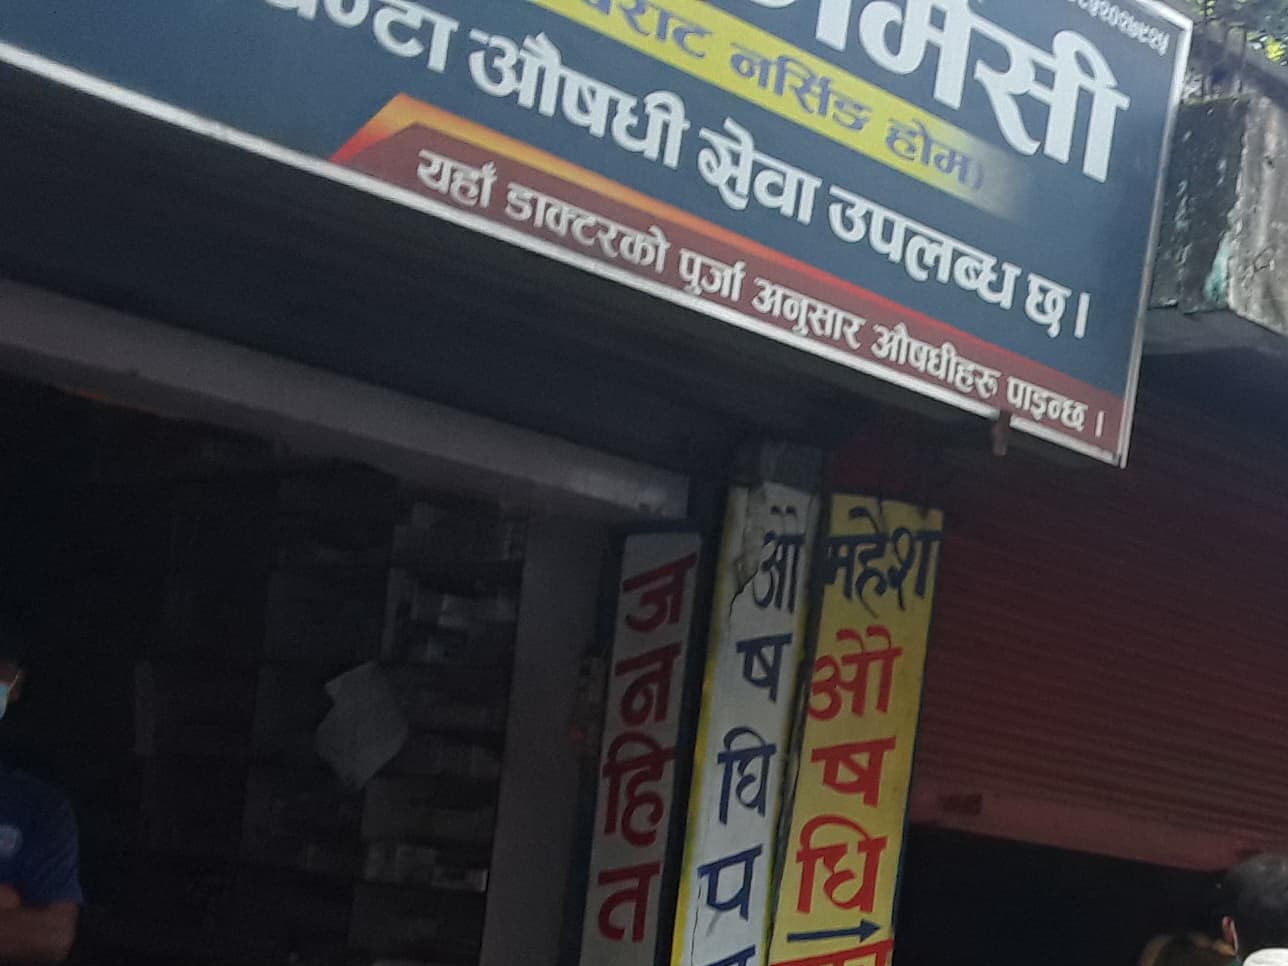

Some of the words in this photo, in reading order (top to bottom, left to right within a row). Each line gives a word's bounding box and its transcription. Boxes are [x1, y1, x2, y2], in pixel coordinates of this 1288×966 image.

[468, 32, 689, 168] औषधी
[699, 117, 822, 225] सेवा
[828, 186, 1020, 312] उपलब्ध
[729, 41, 873, 132] नर्सिङ
[416, 147, 498, 209] यहाँ
[504, 177, 669, 275] डाक्टरको
[678, 246, 748, 302] पुर्जा
[752, 275, 866, 351] अनुसार
[1006, 376, 1089, 433] पाइन्छ
[822, 506, 943, 619] महेश
